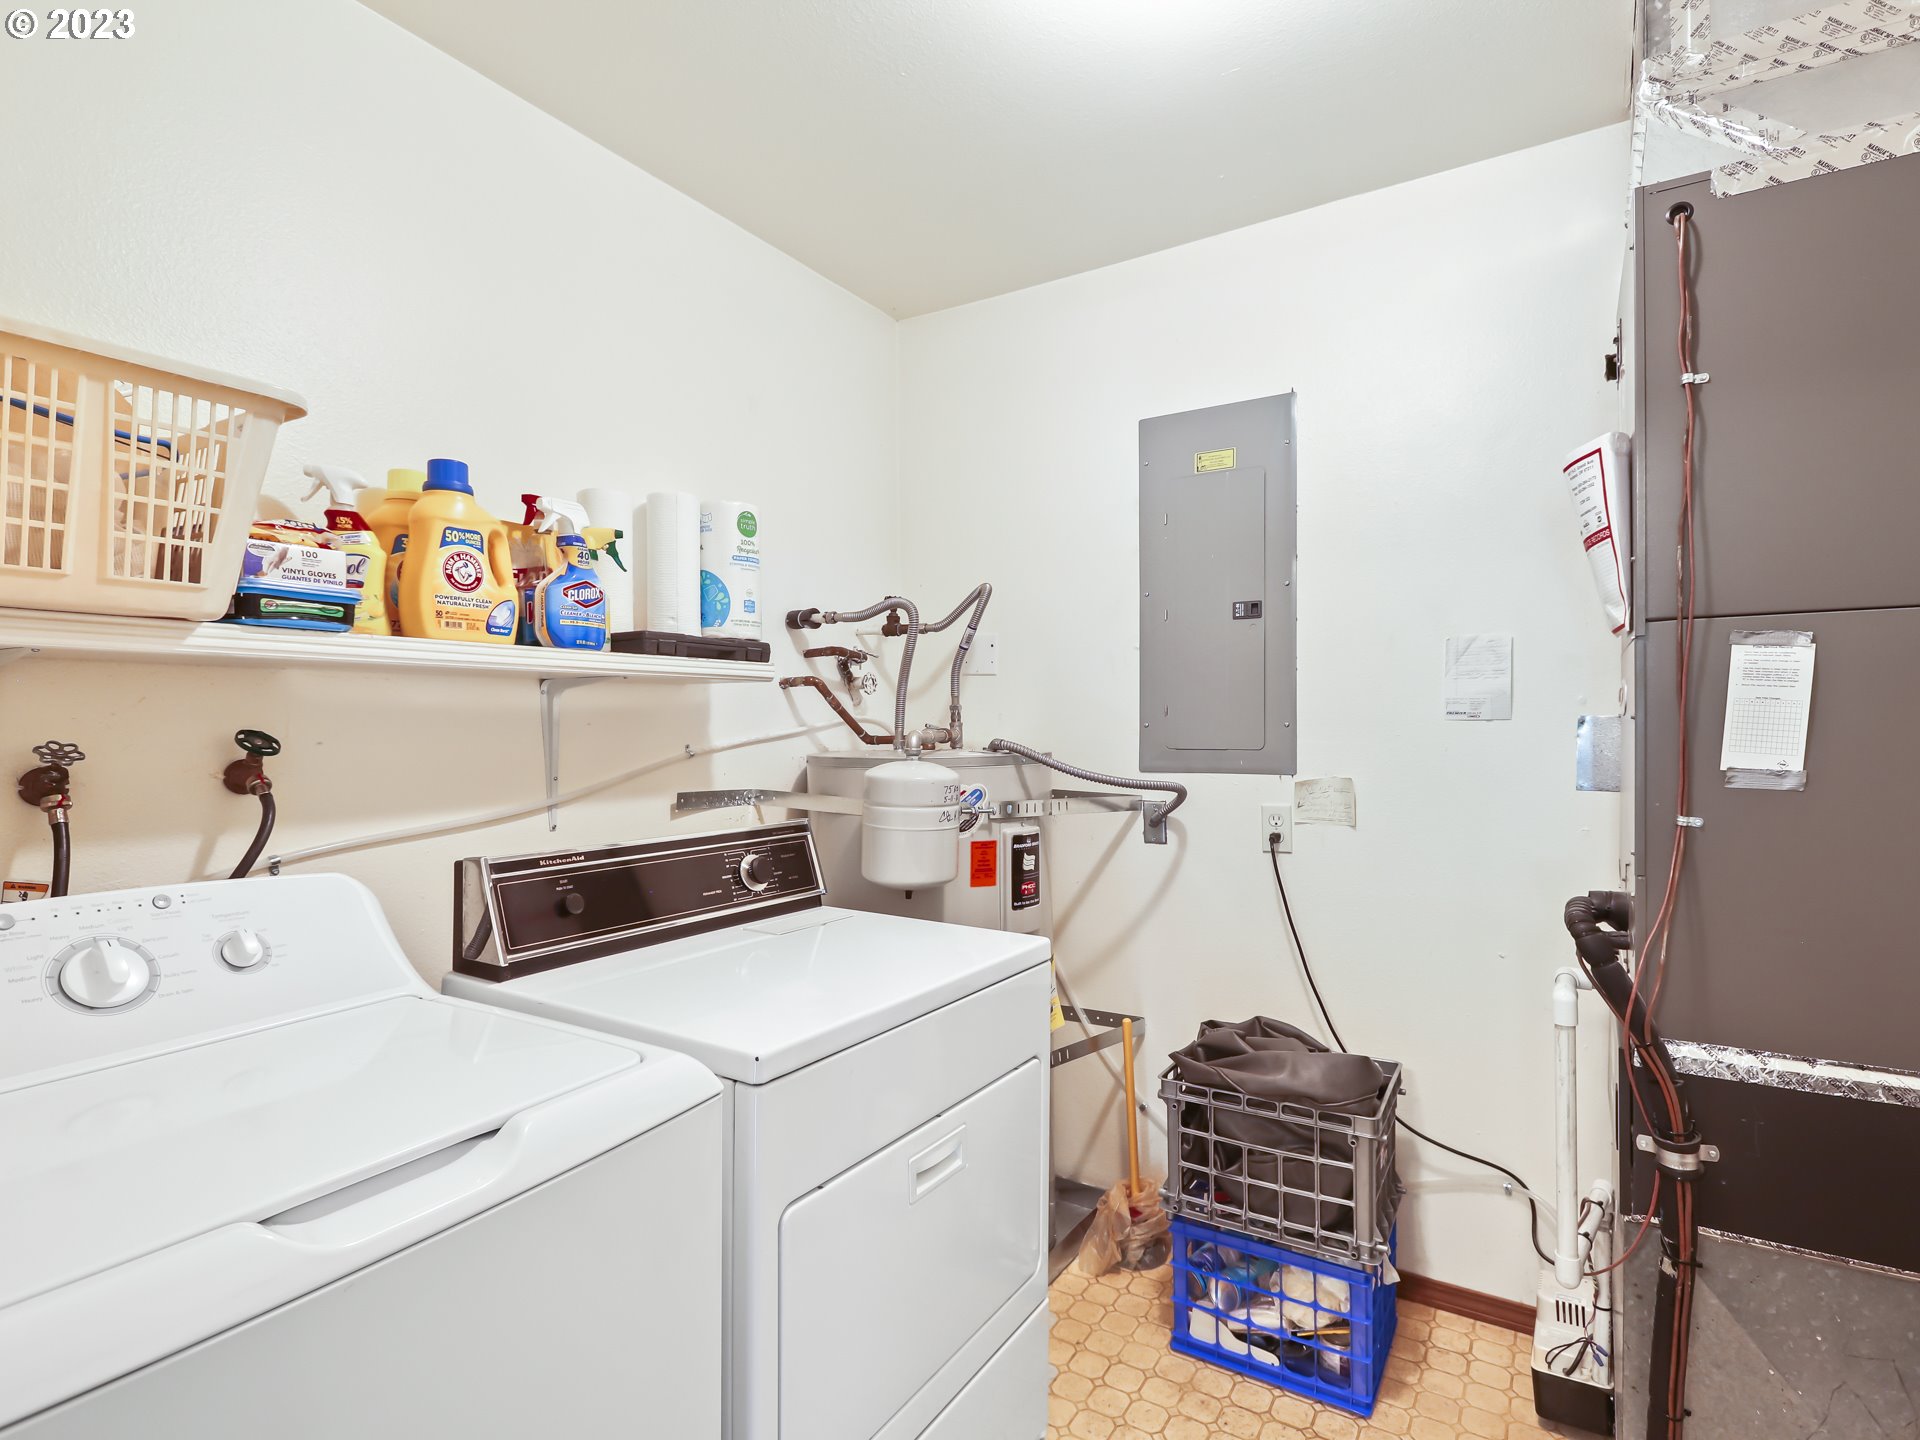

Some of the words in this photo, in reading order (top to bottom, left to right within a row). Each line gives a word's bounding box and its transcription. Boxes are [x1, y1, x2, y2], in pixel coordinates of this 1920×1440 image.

[740, 523, 756, 531] truth
[445, 530, 465, 543] 50%
[465, 533, 482, 541] MORE
[301, 550, 318, 559] 100
[577, 551, 590, 561] 40
[445, 558, 455, 575] ARM
[460, 553, 482, 578] HAMMER
[282, 567, 305, 575] VINYL
[308, 571, 336, 579] GLOVES
[282, 574, 311, 583] GUANTES
[435, 594, 474, 602] POWERFULLY
[568, 587, 600, 601] CLOROX
[540, 855, 584, 866] KitchenAid
[8, 975, 37, 984] Medium
